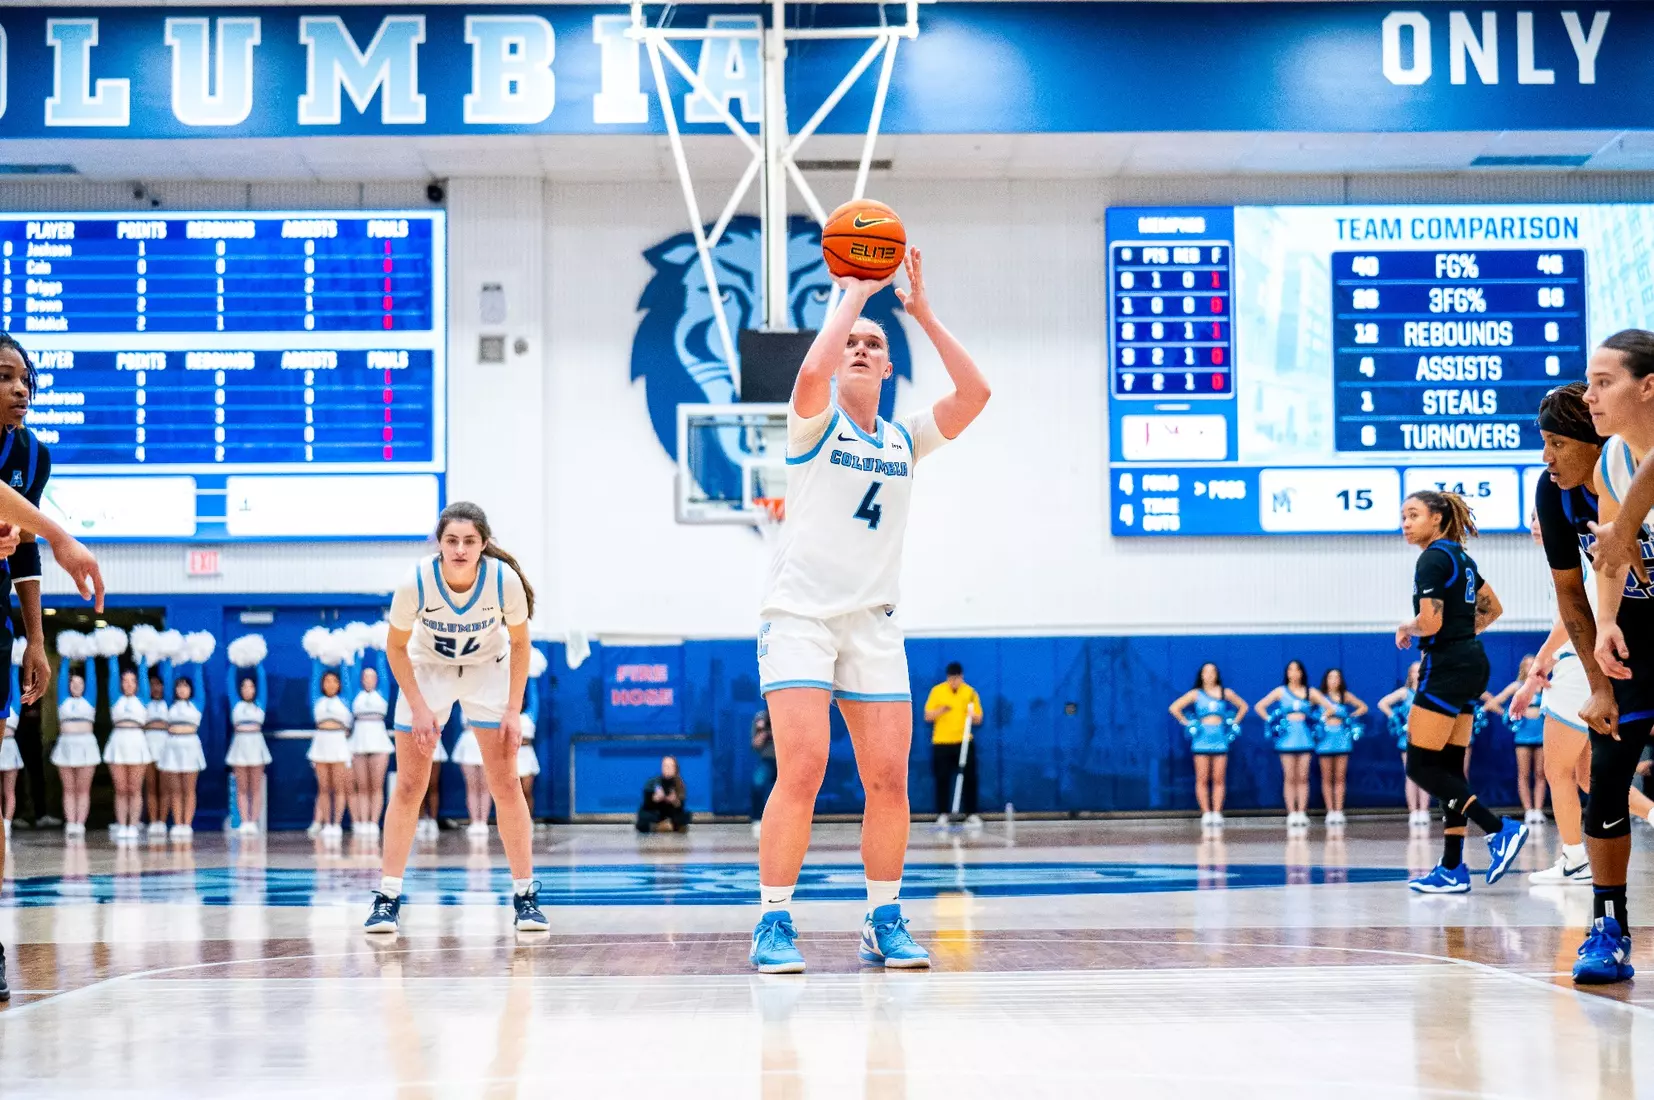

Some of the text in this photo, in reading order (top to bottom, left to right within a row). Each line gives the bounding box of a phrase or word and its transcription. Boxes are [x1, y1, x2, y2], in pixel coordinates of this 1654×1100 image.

[1381, 10, 1611, 85] ONLY
[0, 15, 762, 126] LUMBIA
[26, 221, 75, 239] PLAYER
[1335, 216, 1579, 240] TEAM COMPARISON
[1435, 253, 1479, 279] FG%
[1151, 271, 1162, 289] 1
[1182, 271, 1195, 289] 0
[1211, 271, 1221, 289] 1
[1121, 297, 1134, 315] 1
[1151, 296, 1163, 314] 0
[1183, 296, 1195, 314] 0
[1428, 287, 1487, 313] 3FG%
[1184, 321, 1195, 340] 1
[1212, 321, 1222, 339] 1
[1404, 320, 1513, 347] REBOUNDS
[27, 351, 74, 369] PLAYER
[1184, 347, 1195, 365] 1
[1415, 355, 1502, 381] ASSISTS
[1121, 373, 1135, 391] 7
[1185, 372, 1195, 390] 1
[1361, 389, 1497, 415] 1 STEALS
[1399, 423, 1521, 450] TURNOVERS
[830, 449, 908, 477] COLUMBIA
[853, 480, 883, 530] 4
[1336, 488, 1374, 511] 15
[1464, 567, 1476, 604] 2
[421, 616, 496, 633] COLUMBIA
